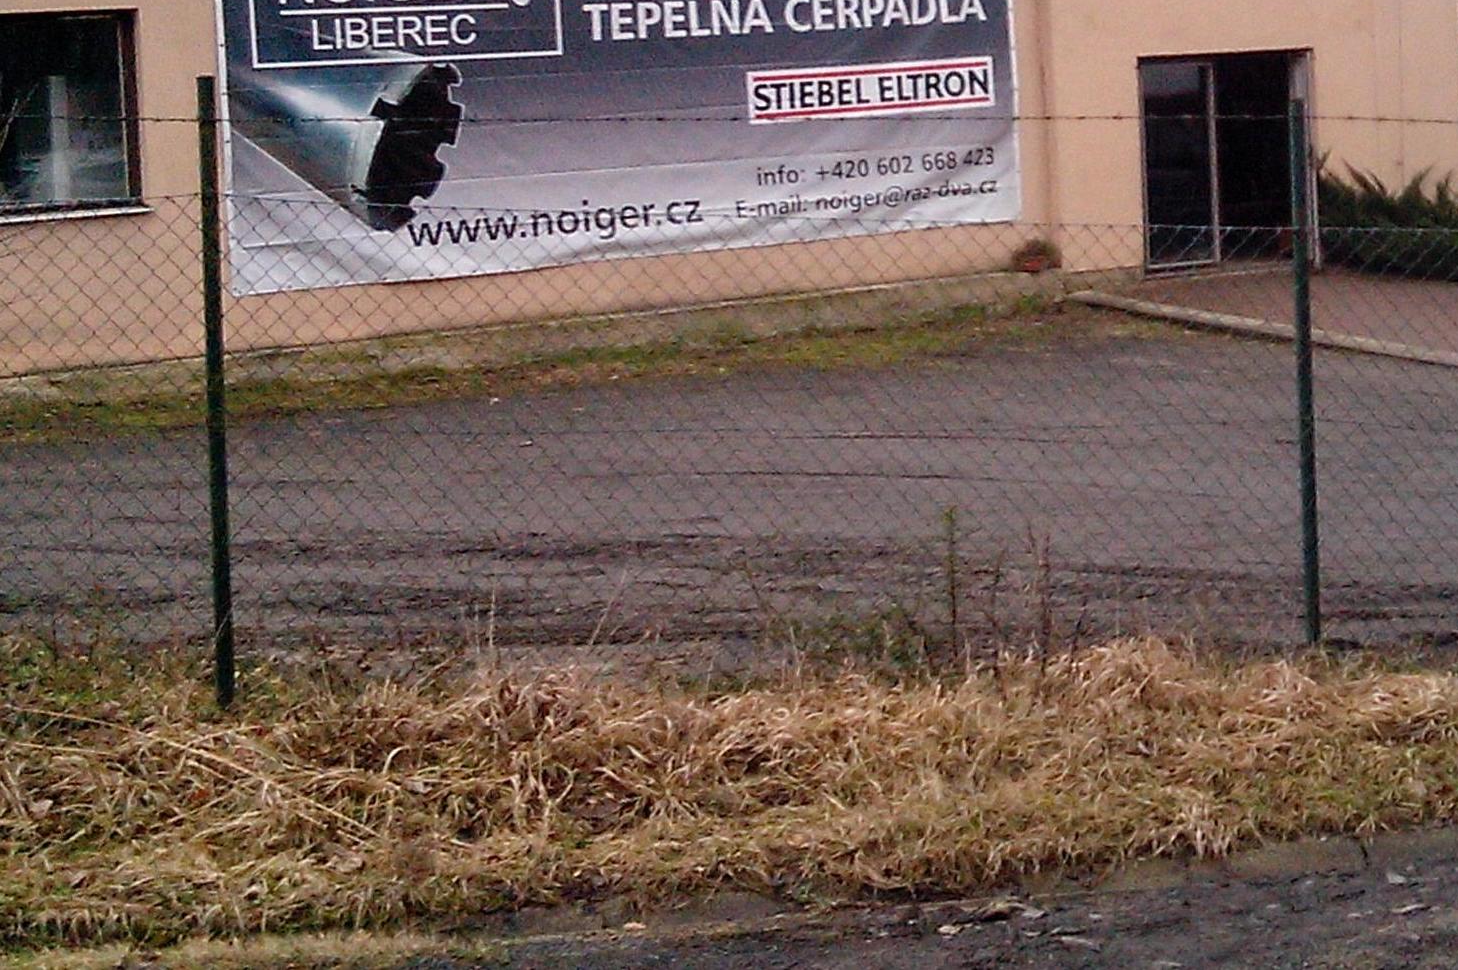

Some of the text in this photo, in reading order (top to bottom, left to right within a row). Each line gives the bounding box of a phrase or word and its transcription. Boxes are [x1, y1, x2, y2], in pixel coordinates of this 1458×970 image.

[311, 13, 477, 50] LIBEREC
[753, 68, 990, 112] STIEBEL ELTRON
[756, 146, 995, 187] info: +420 602 668 423
[406, 199, 704, 248] www.noiger.cz
[735, 193, 808, 220] E-mail:
